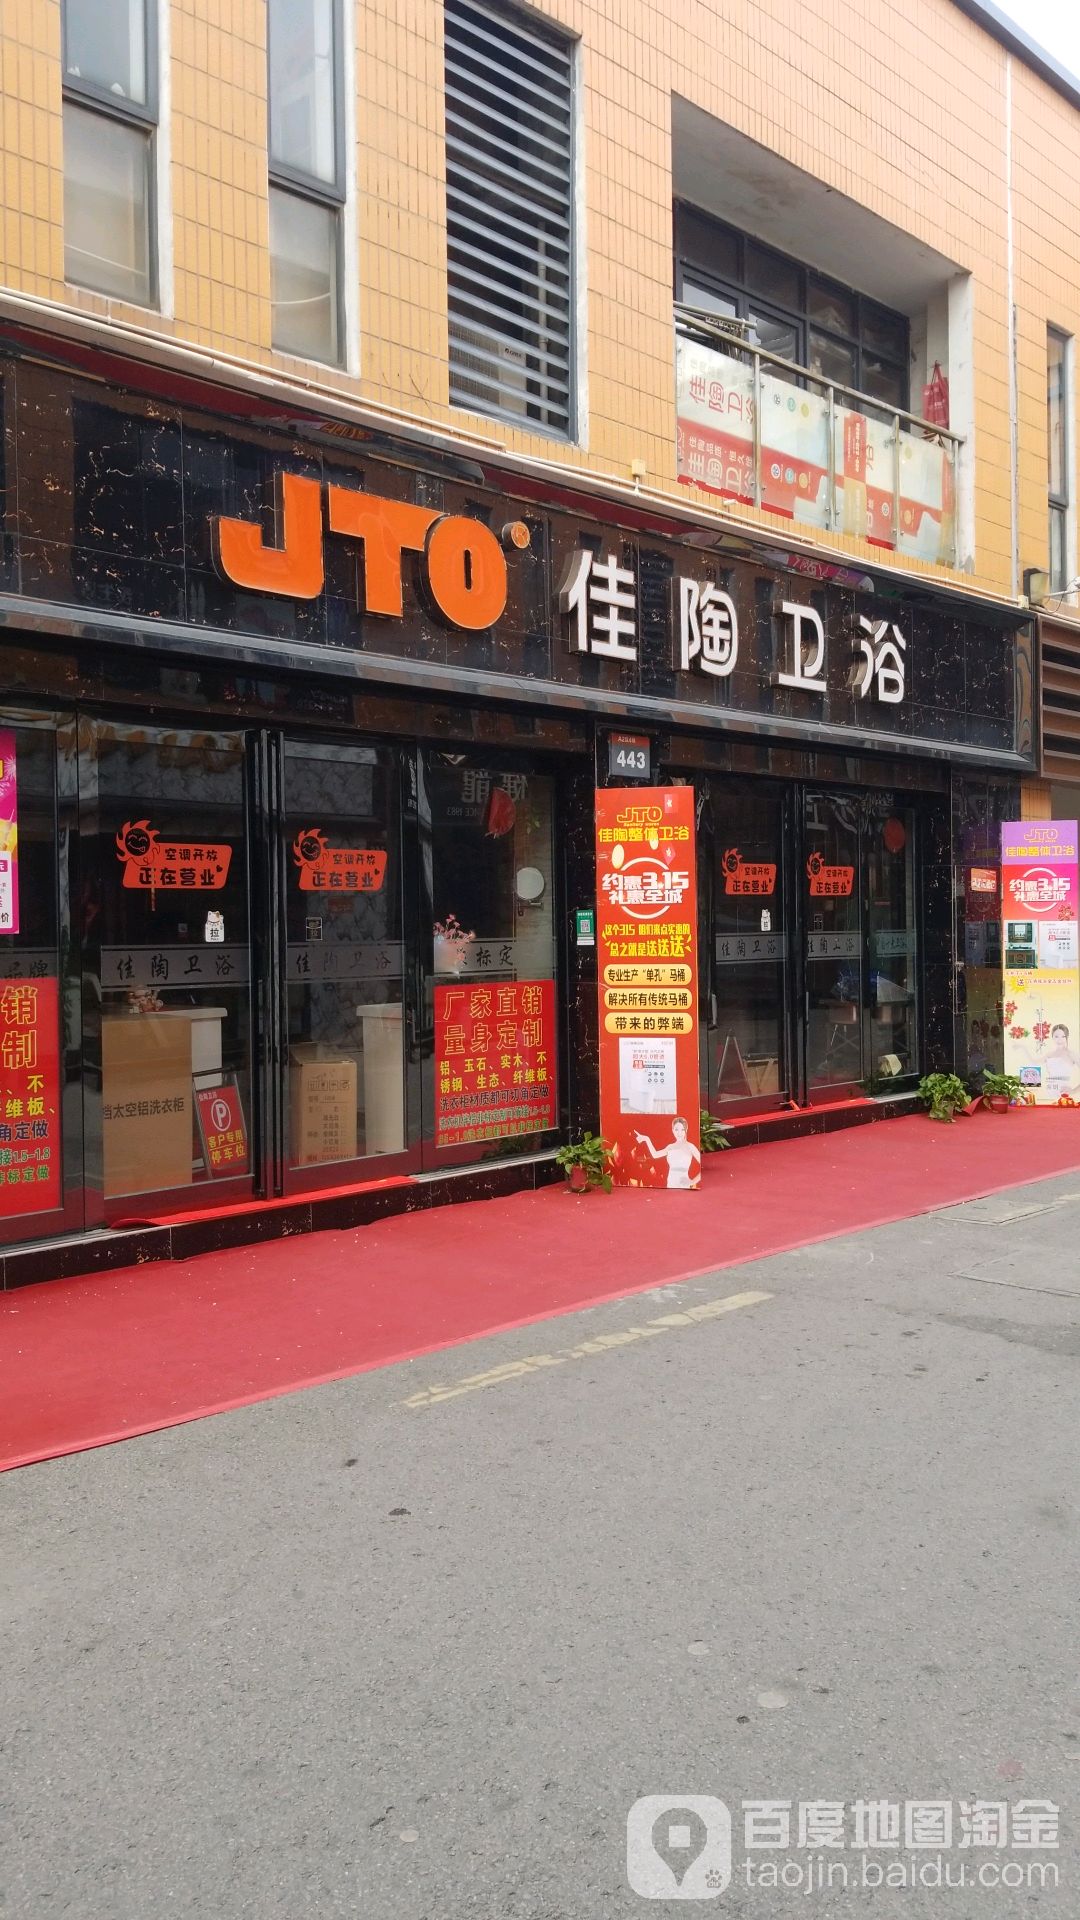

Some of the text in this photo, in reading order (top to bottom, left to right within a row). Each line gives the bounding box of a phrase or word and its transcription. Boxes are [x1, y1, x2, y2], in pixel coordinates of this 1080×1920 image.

[212, 471, 508, 630] JTO
[562, 550, 906, 703] 佳陶卫浴
[616, 750, 646, 769] 443
[617, 806, 663, 823] JTO
[598, 826, 690, 843] 佳陶整体卫浴
[1023, 828, 1058, 841] JTO
[165, 848, 218, 861] 空调开放
[333, 854, 376, 865] 空调开放
[139, 867, 215, 886] 正在营业
[313, 871, 374, 887] 正在营业
[602, 871, 689, 890] 约惠3.15
[1009, 877, 1071, 892] 约惠3.15
[732, 880, 769, 893] 正在营业
[816, 881, 847, 894] 正在营业
[608, 889, 683, 905] 礼惠全城
[1014, 890, 1067, 902] 礼惠全城
[210, 928, 220, 938] 拉
[721, 938, 777, 957] 佳陶卫浴
[116, 952, 235, 980] 佳陶卫浴
[443, 986, 543, 1021] 厂家直销
[608, 993, 688, 1006] 解决所有传统马桶
[614, 1016, 685, 1031] 带来的弊端
[444, 1018, 543, 1056] 量身定制
[215, 1103, 227, 1128] P
[207, 1129, 244, 1148] 客户专用
[211, 1143, 246, 1164] 停车位
